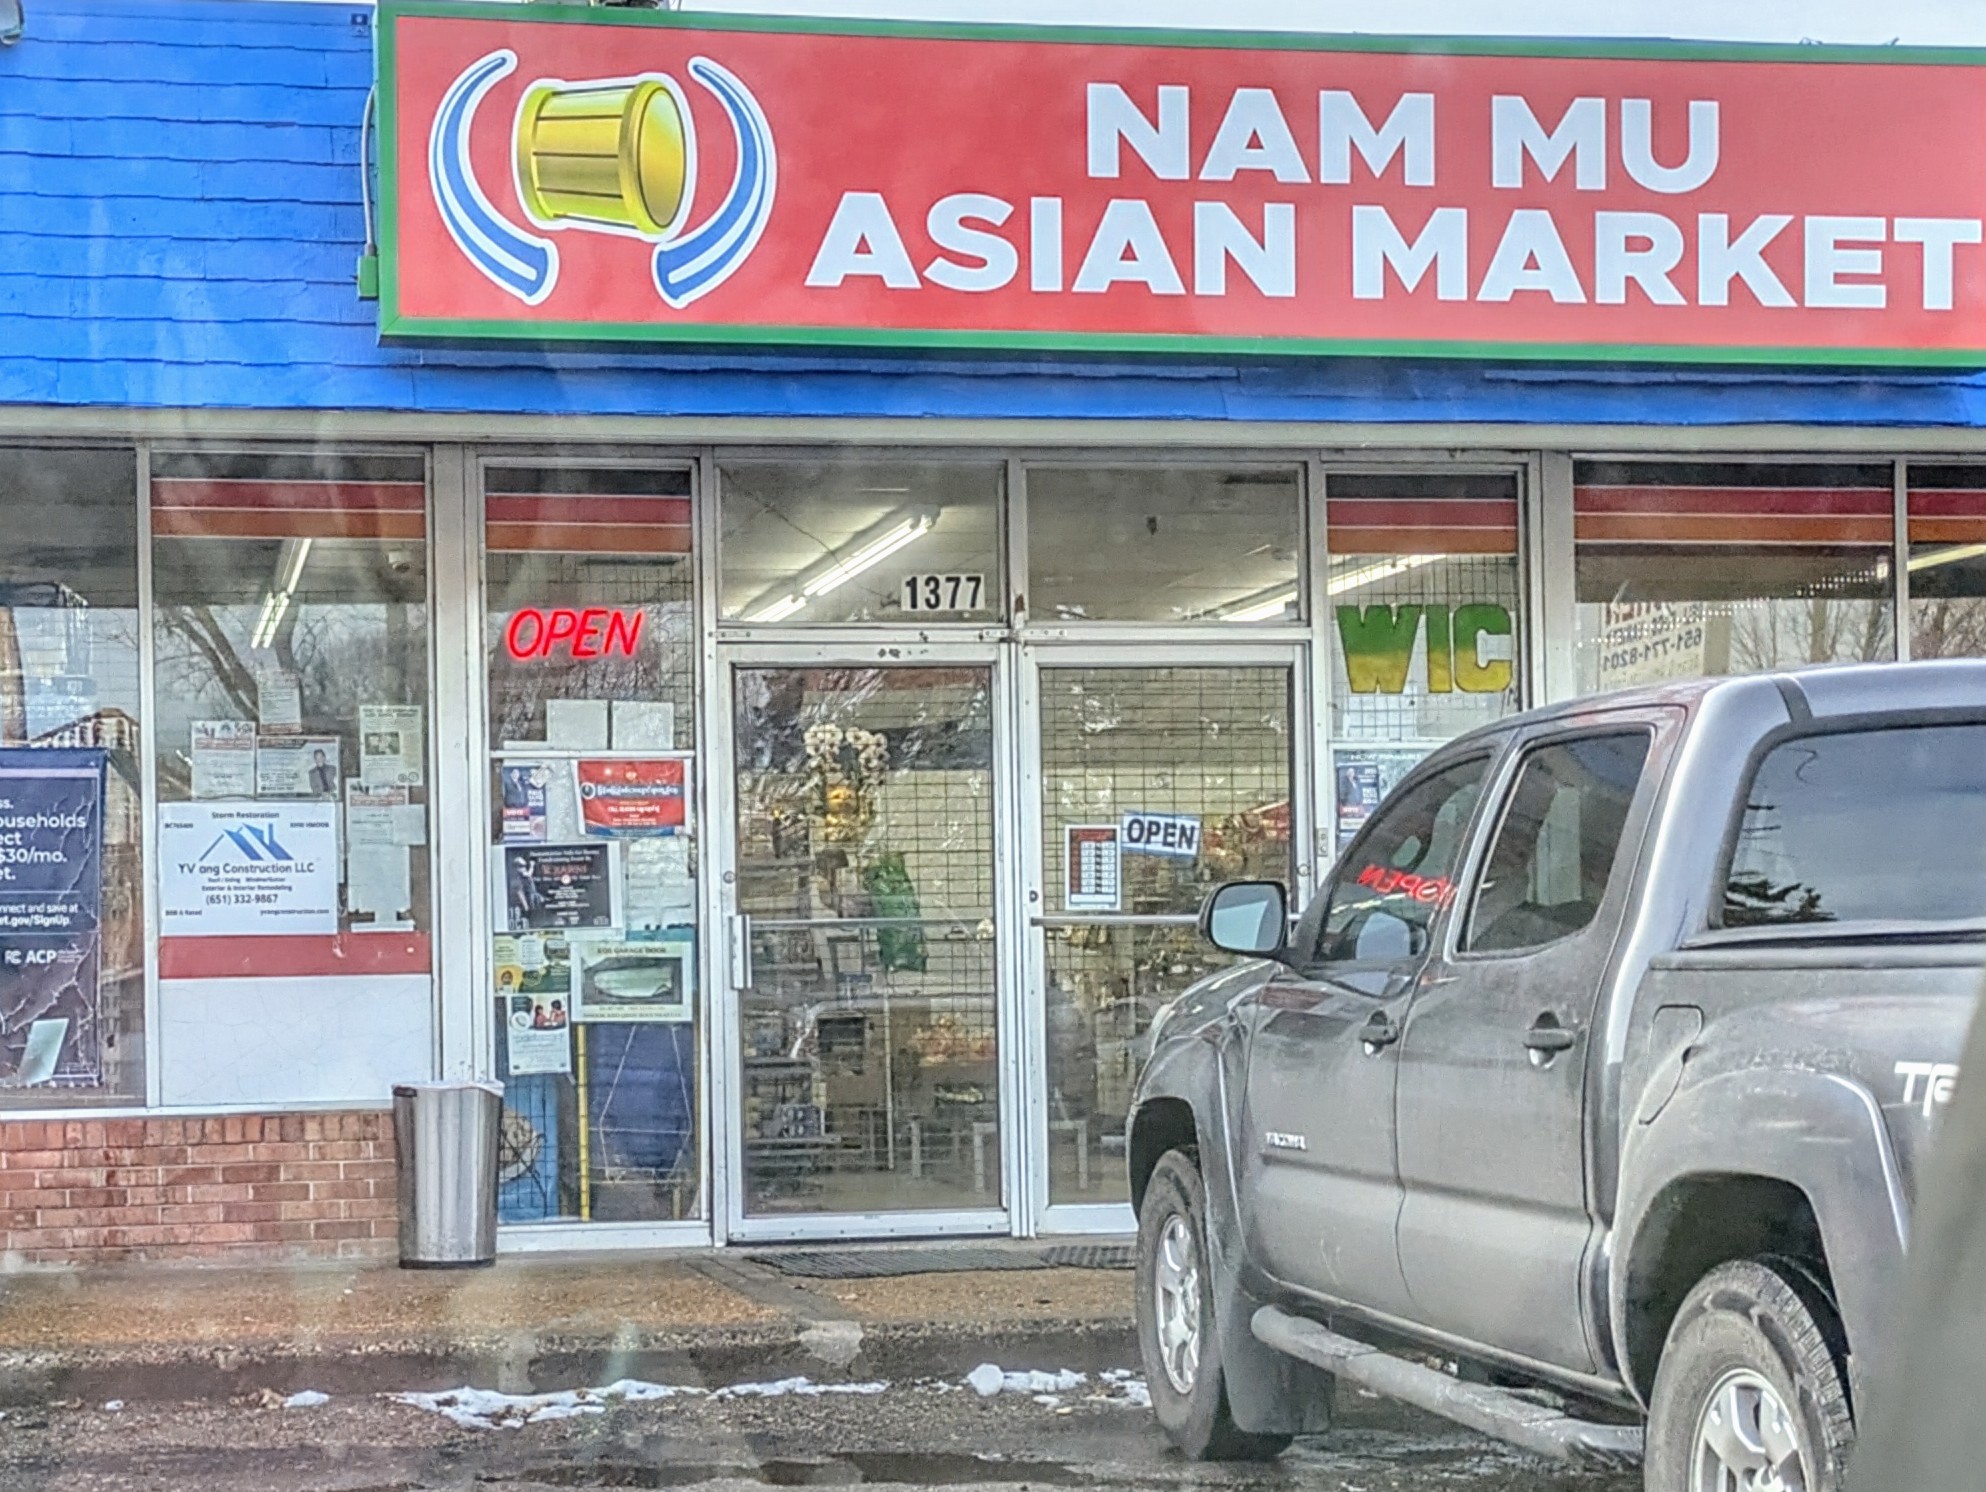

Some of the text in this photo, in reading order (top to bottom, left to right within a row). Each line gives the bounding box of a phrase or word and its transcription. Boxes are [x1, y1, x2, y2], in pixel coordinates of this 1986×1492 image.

[1087, 82, 1720, 194] NAM MU
[804, 192, 1983, 310] ASIAN MARKET
[904, 575, 983, 609] 1377
[505, 607, 644, 660] OPEN
[1336, 604, 1512, 694] WIC
[212, 811, 280, 820] Storm Restoration
[1127, 818, 1196, 850] OPEN
[178, 861, 315, 876] YV ang Construction LLC
[28, 902, 45, 914] and
[46, 904, 68, 914] save
[69, 903, 79, 914] at
[206, 893, 279, 905] (651) 332-9867
[25, 949, 57, 964] ACP
